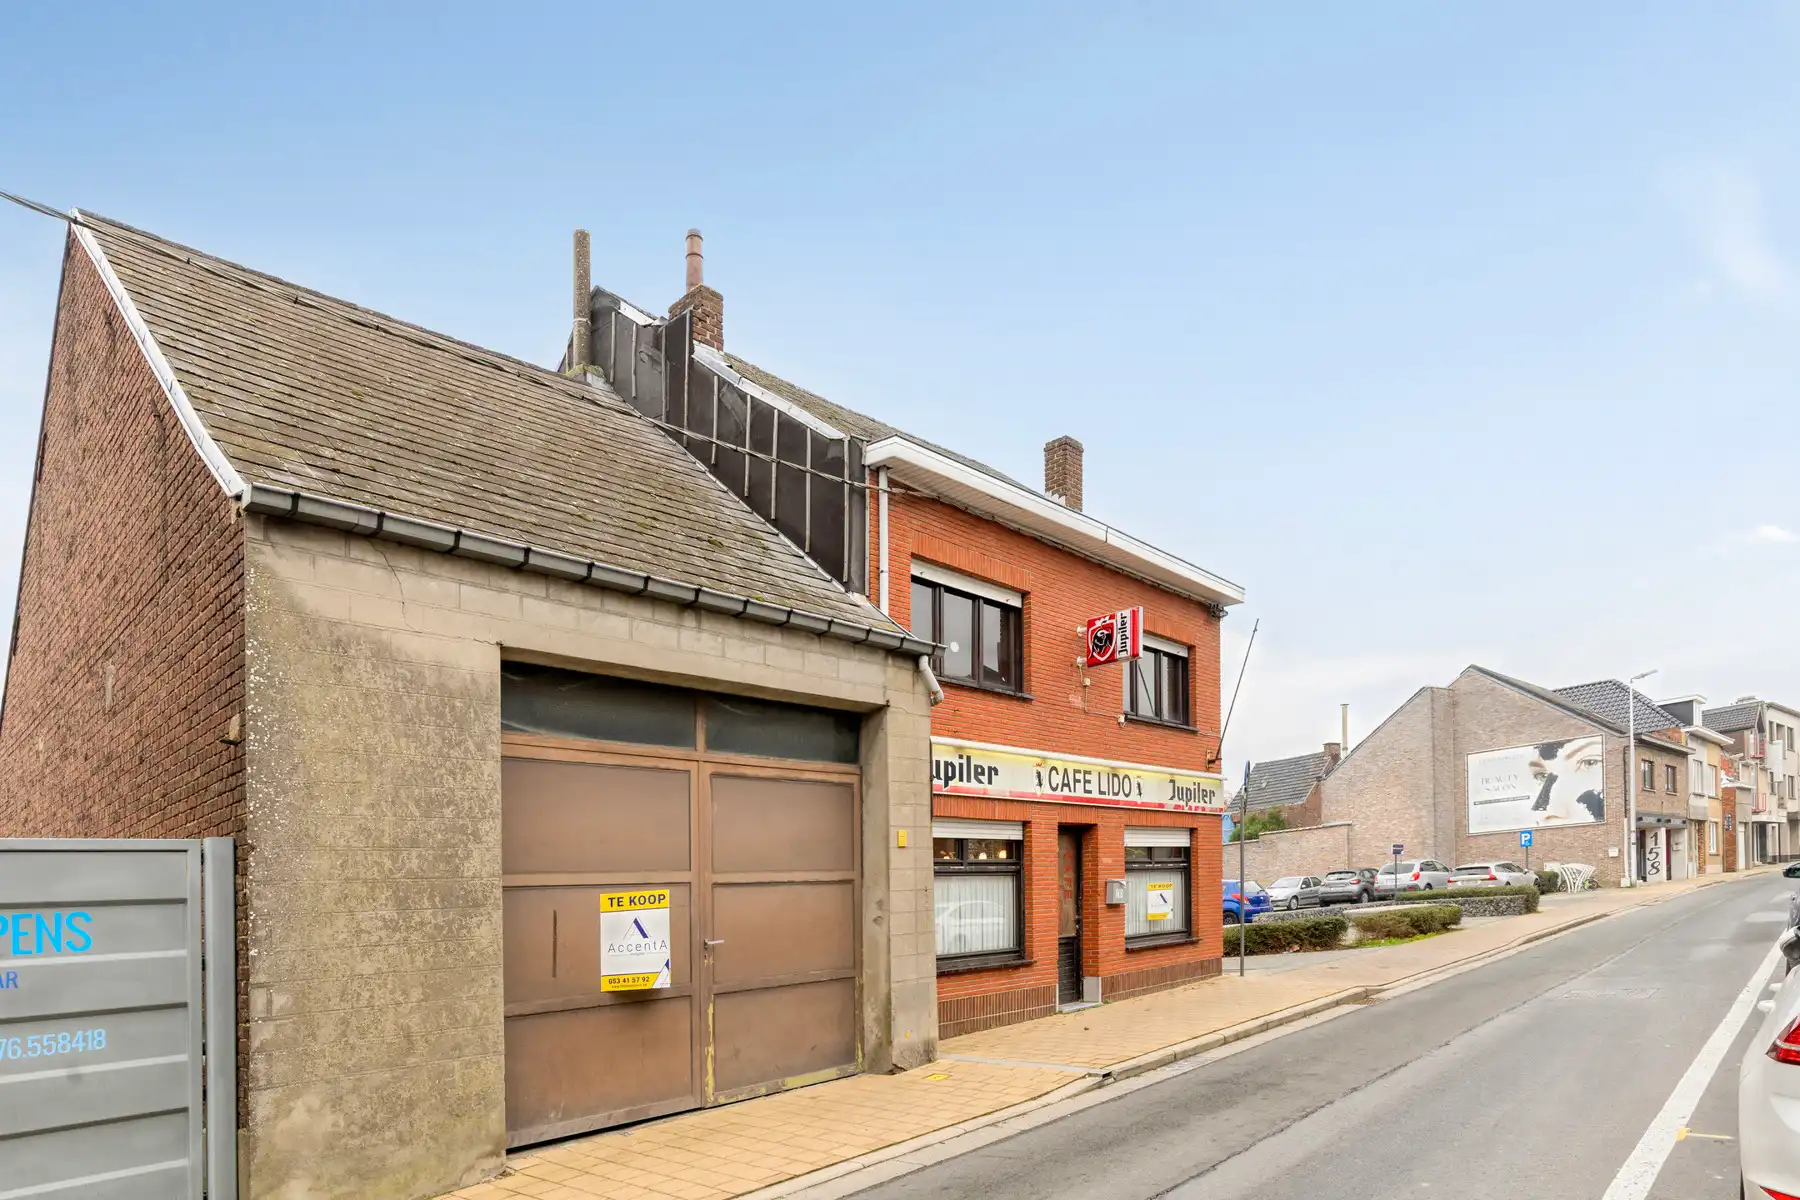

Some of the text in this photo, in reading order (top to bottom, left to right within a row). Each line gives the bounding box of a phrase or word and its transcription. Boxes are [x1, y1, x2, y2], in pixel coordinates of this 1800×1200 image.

[1118, 612, 1129, 656] Jupiler
[1048, 765, 1132, 798] CAFE LIDO
[1168, 779, 1216, 807] Jupiler
[1521, 833, 1530, 845] P
[1646, 831, 1661, 876] 158
[607, 893, 666, 908] TE KOOP
[607, 939, 668, 953] AccentA
[608, 977, 621, 985] 053
[631, 976, 640, 984] 57
